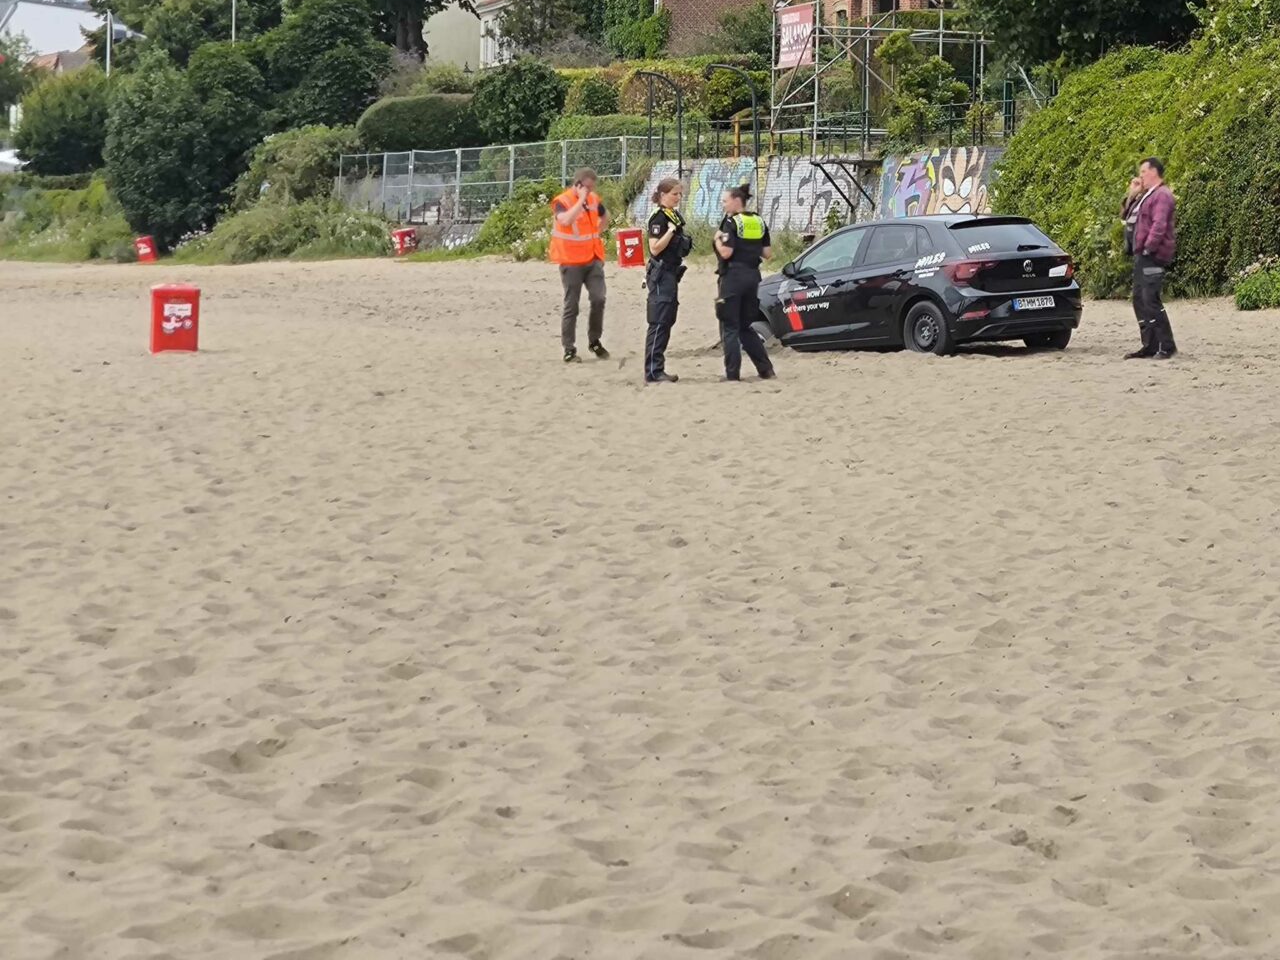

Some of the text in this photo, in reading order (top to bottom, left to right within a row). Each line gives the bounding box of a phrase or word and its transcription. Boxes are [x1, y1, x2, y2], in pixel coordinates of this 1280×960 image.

[967, 242, 991, 254] MILES
[914, 251, 946, 269] MILES
[806, 290, 820, 299] NOW
[783, 301, 830, 314] Get there your way
